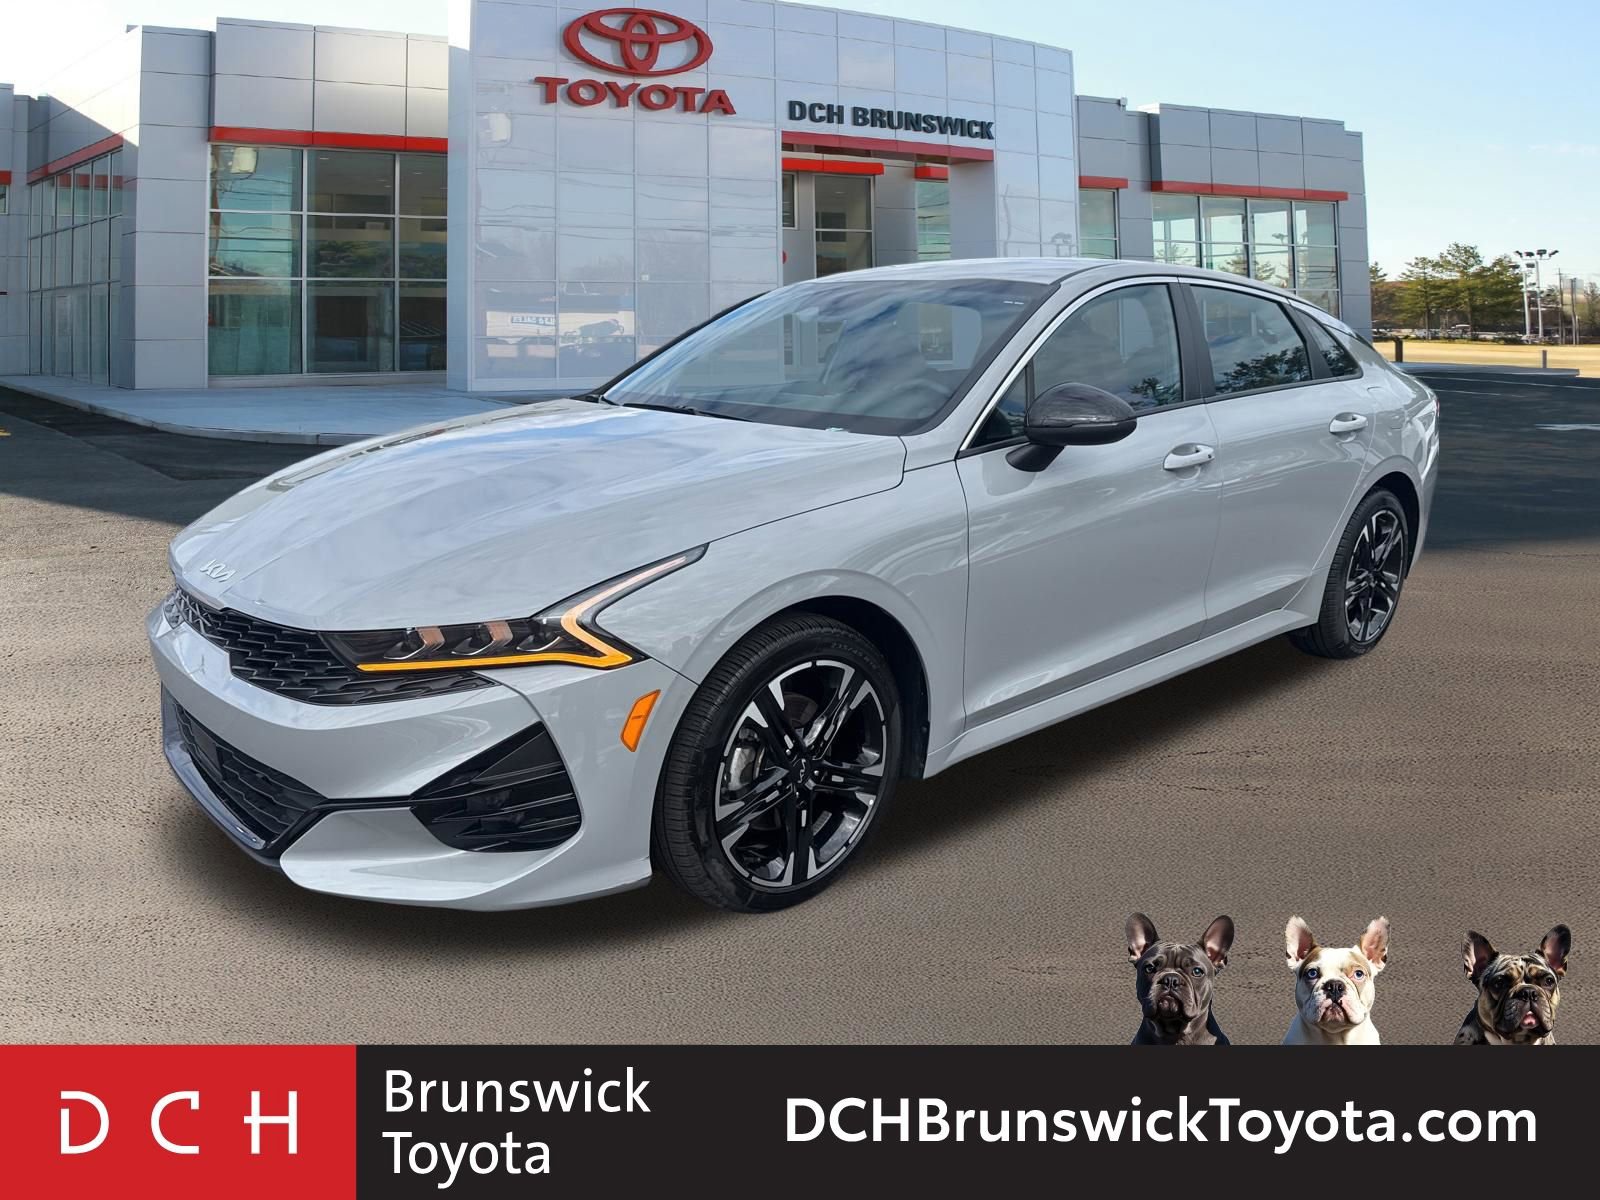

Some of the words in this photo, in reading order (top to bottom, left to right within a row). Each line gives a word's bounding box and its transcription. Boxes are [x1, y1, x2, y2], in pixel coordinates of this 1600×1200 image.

[534, 76, 737, 115] TOYOTA
[788, 99, 846, 125] DCH
[851, 106, 995, 141] BRUNSWICK
